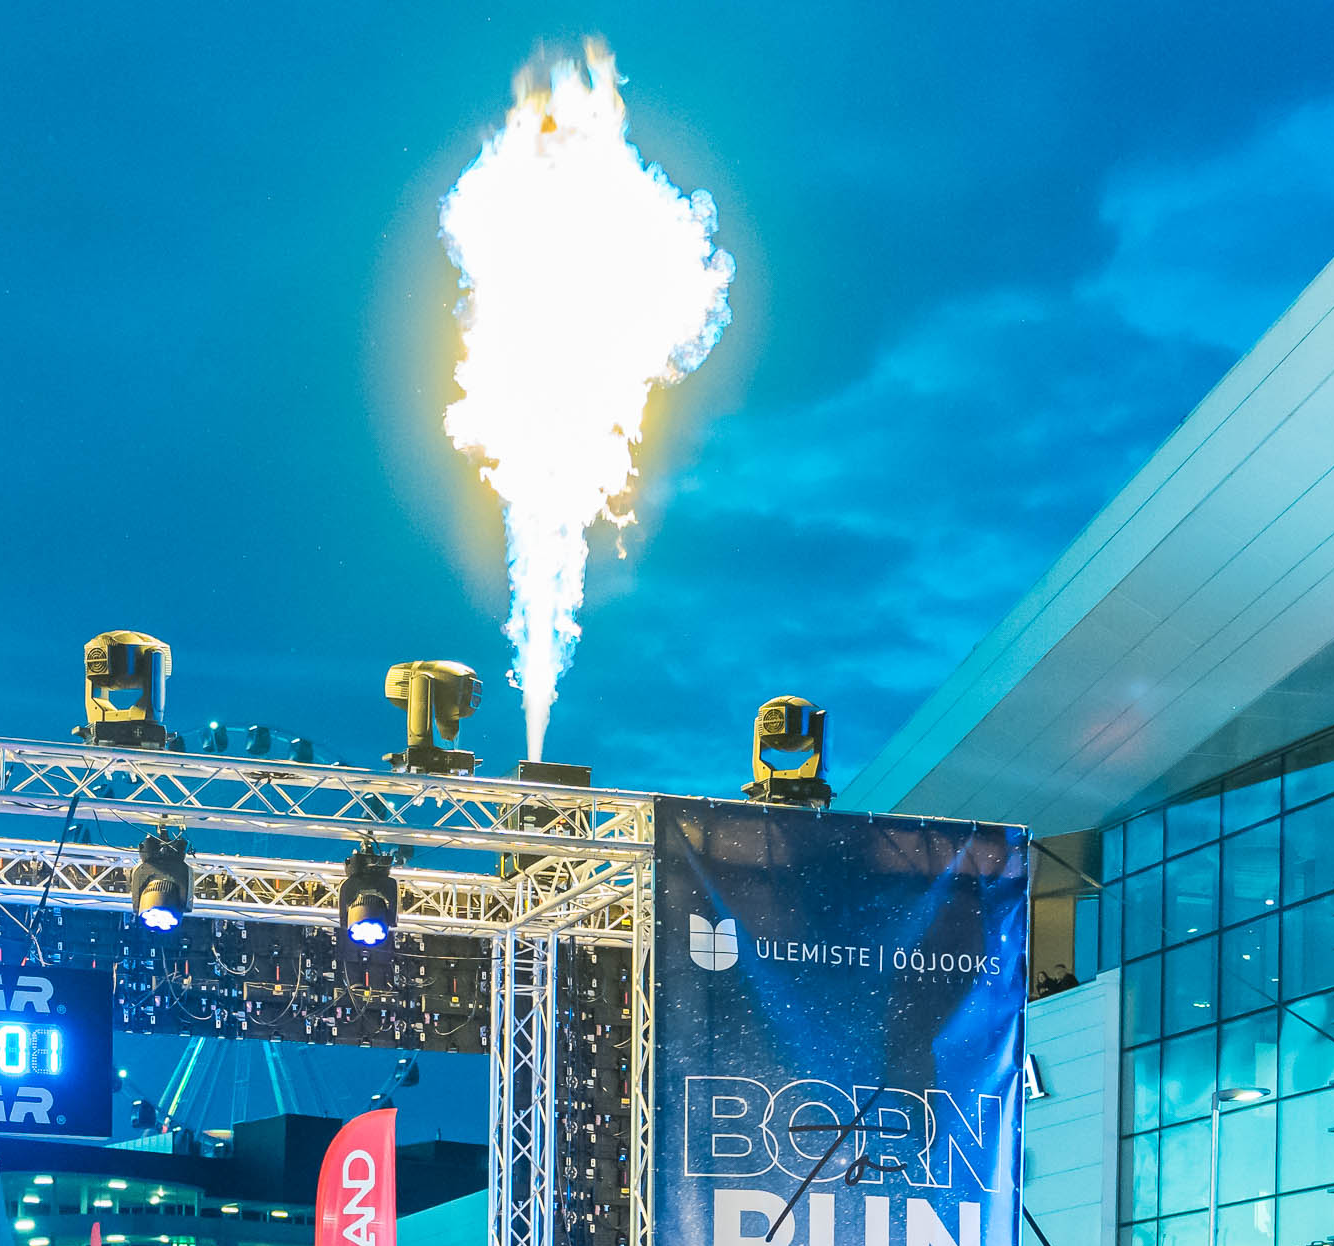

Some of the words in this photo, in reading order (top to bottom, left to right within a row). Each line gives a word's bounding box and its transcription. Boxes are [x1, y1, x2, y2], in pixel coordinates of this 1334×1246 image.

[756, 937, 870, 967] ÜLEMISTE
[893, 947, 1001, 975] ÖÖJOOKS
[904, 975, 992, 986] TALLINN
[684, 1076, 1002, 1193] BORN
